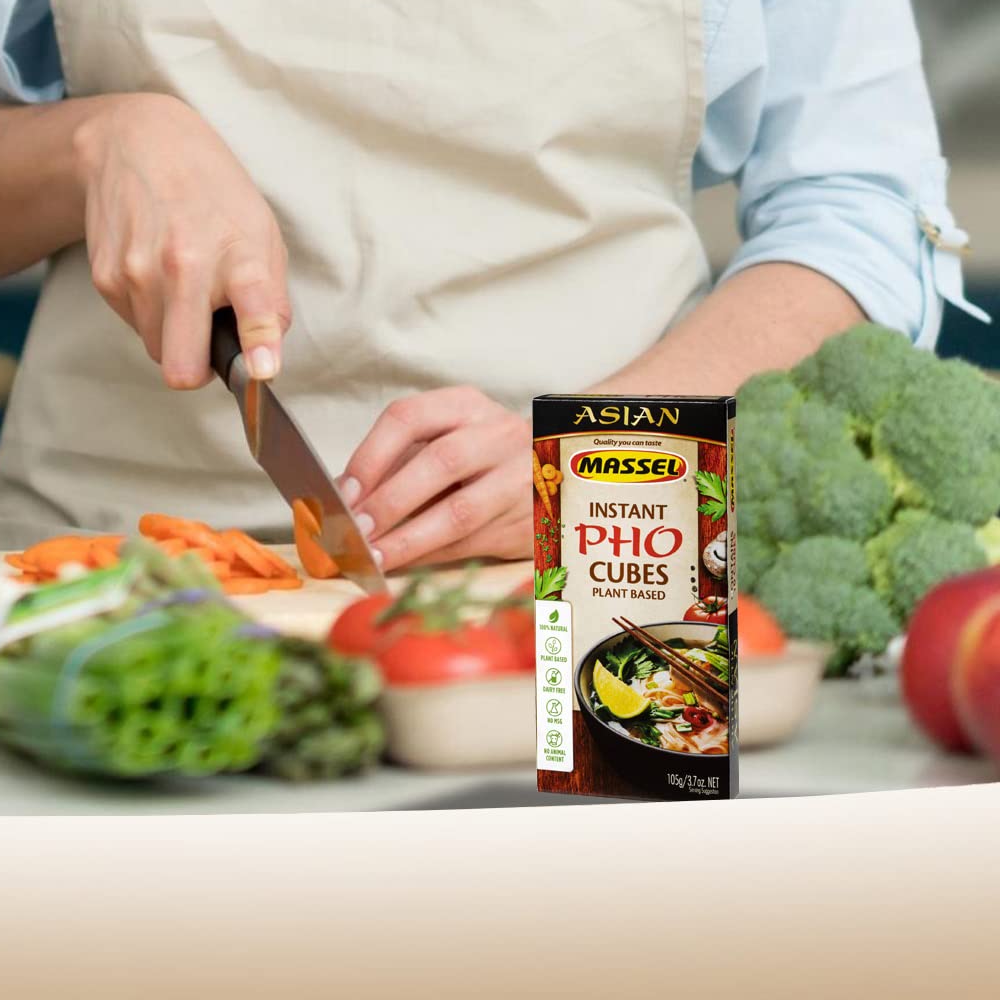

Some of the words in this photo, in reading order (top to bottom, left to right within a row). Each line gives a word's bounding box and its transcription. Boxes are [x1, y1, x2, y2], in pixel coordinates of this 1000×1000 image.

[573, 405, 680, 427] ASIAN
[594, 438, 617, 447] Quality
[644, 439, 662, 447] taste
[578, 457, 680, 476] MASSEL
[589, 502, 668, 520] INSTANT
[574, 523, 683, 558] PHO
[589, 561, 669, 585] CUBES
[592, 588, 629, 599] PLANT
[630, 589, 666, 601] BASED
[550, 625, 568, 633] NATURAL
[707, 776, 719, 788] NET
